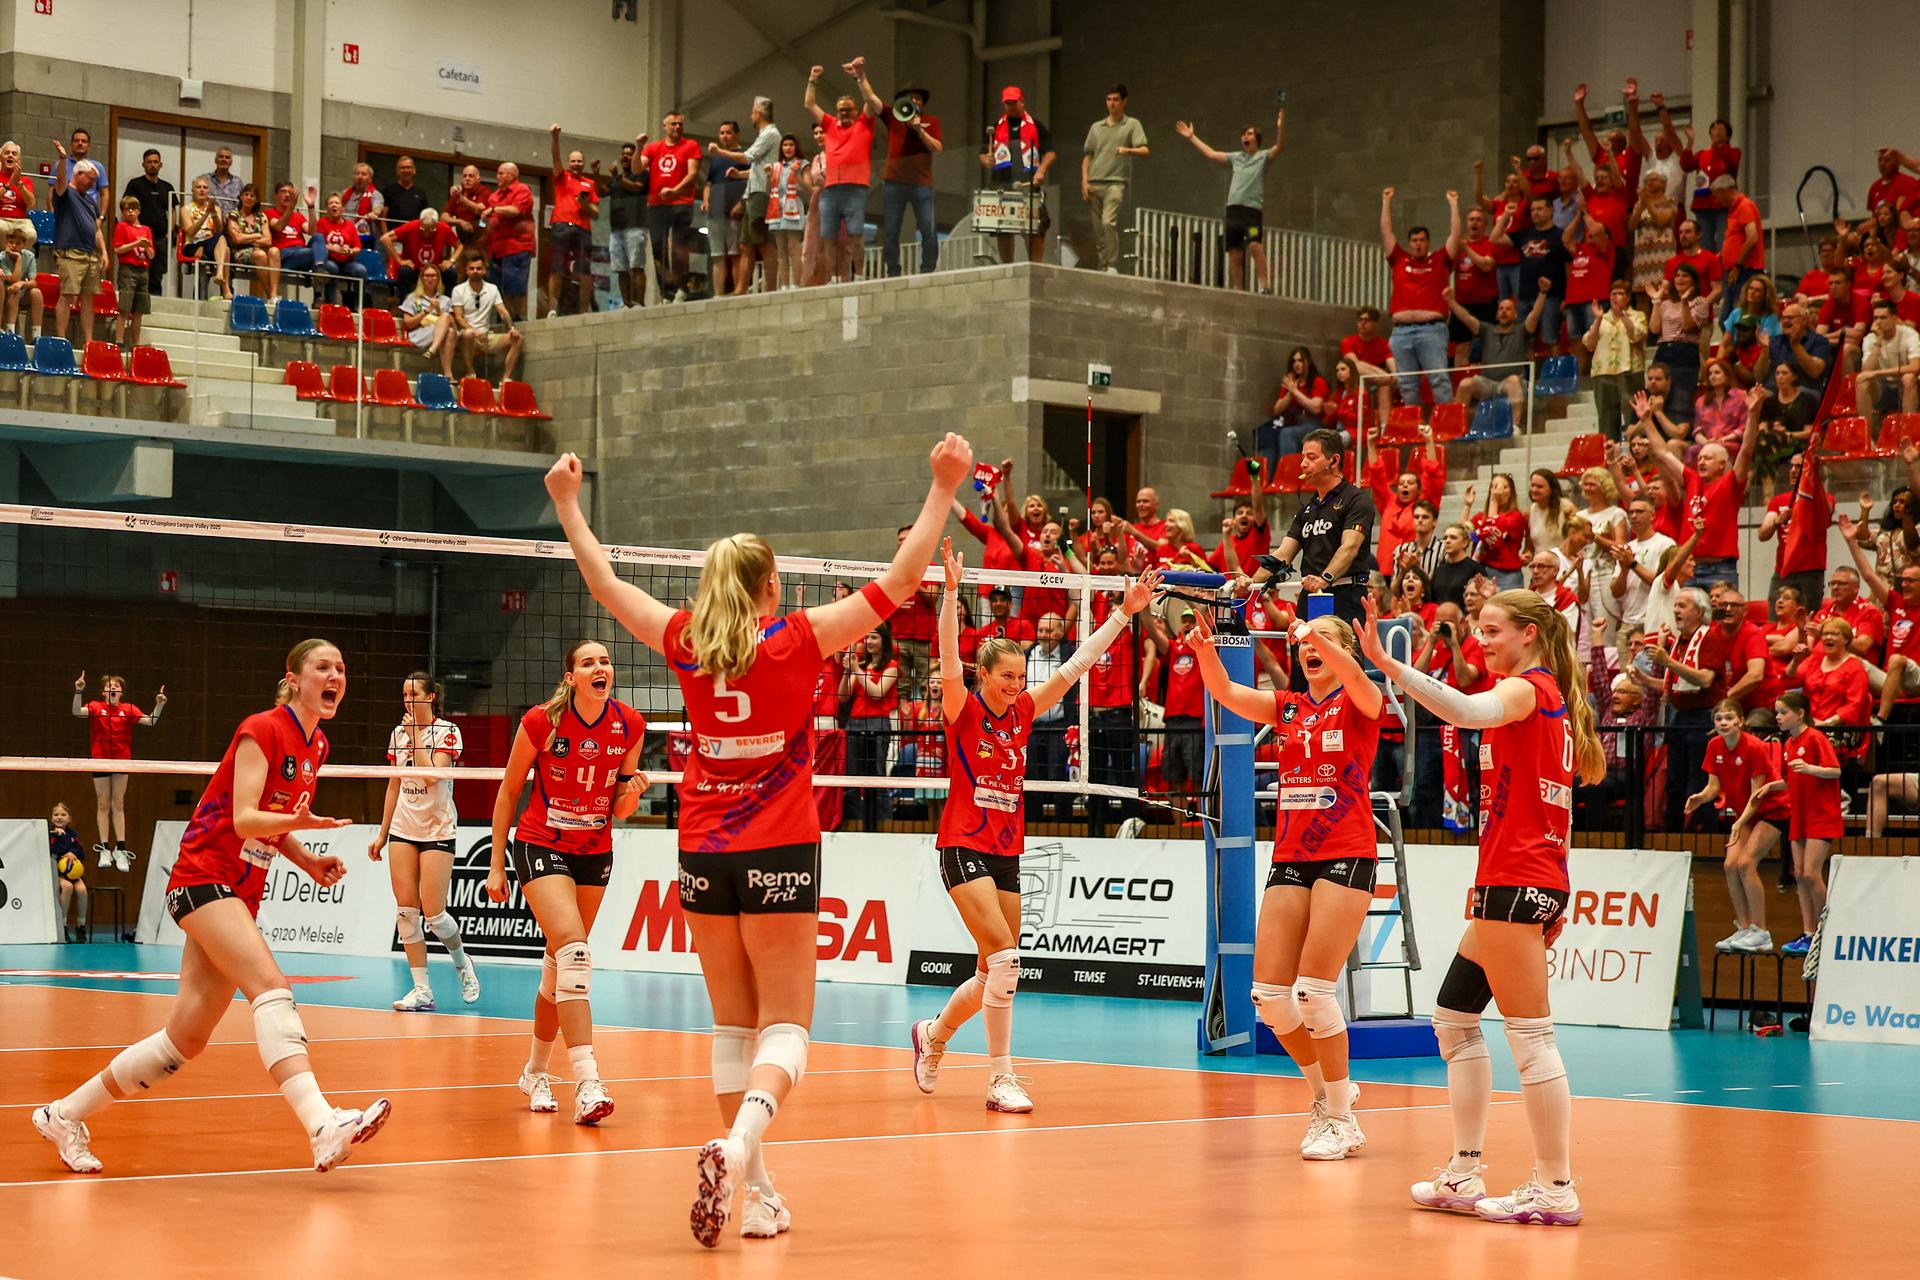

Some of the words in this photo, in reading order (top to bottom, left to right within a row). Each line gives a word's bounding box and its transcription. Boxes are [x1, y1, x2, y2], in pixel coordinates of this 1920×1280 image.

[439, 68, 479, 83] Cafetaria
[1049, 576, 1065, 585] CEV
[1222, 636, 1250, 646] BOSAN
[714, 672, 751, 723] 5
[735, 734, 784, 747] BEVEREN
[576, 765, 596, 792] 4
[1287, 775, 1312, 784] PIETERS
[535, 858, 545, 871] 4
[966, 861, 977, 873] 3
[679, 864, 709, 891] emo
[747, 869, 812, 889] Remo
[283, 871, 345, 904] Deleu
[762, 886, 797, 905] Frit
[1069, 876, 1174, 902] IVECO
[271, 927, 297, 943] 9120
[299, 925, 345, 944] Melsele
[1018, 932, 1165, 957] CAMMAERT
[920, 962, 953, 975] GOOIK
[1073, 970, 1106, 984] TEMSE
[1826, 1003, 1856, 1026] De
